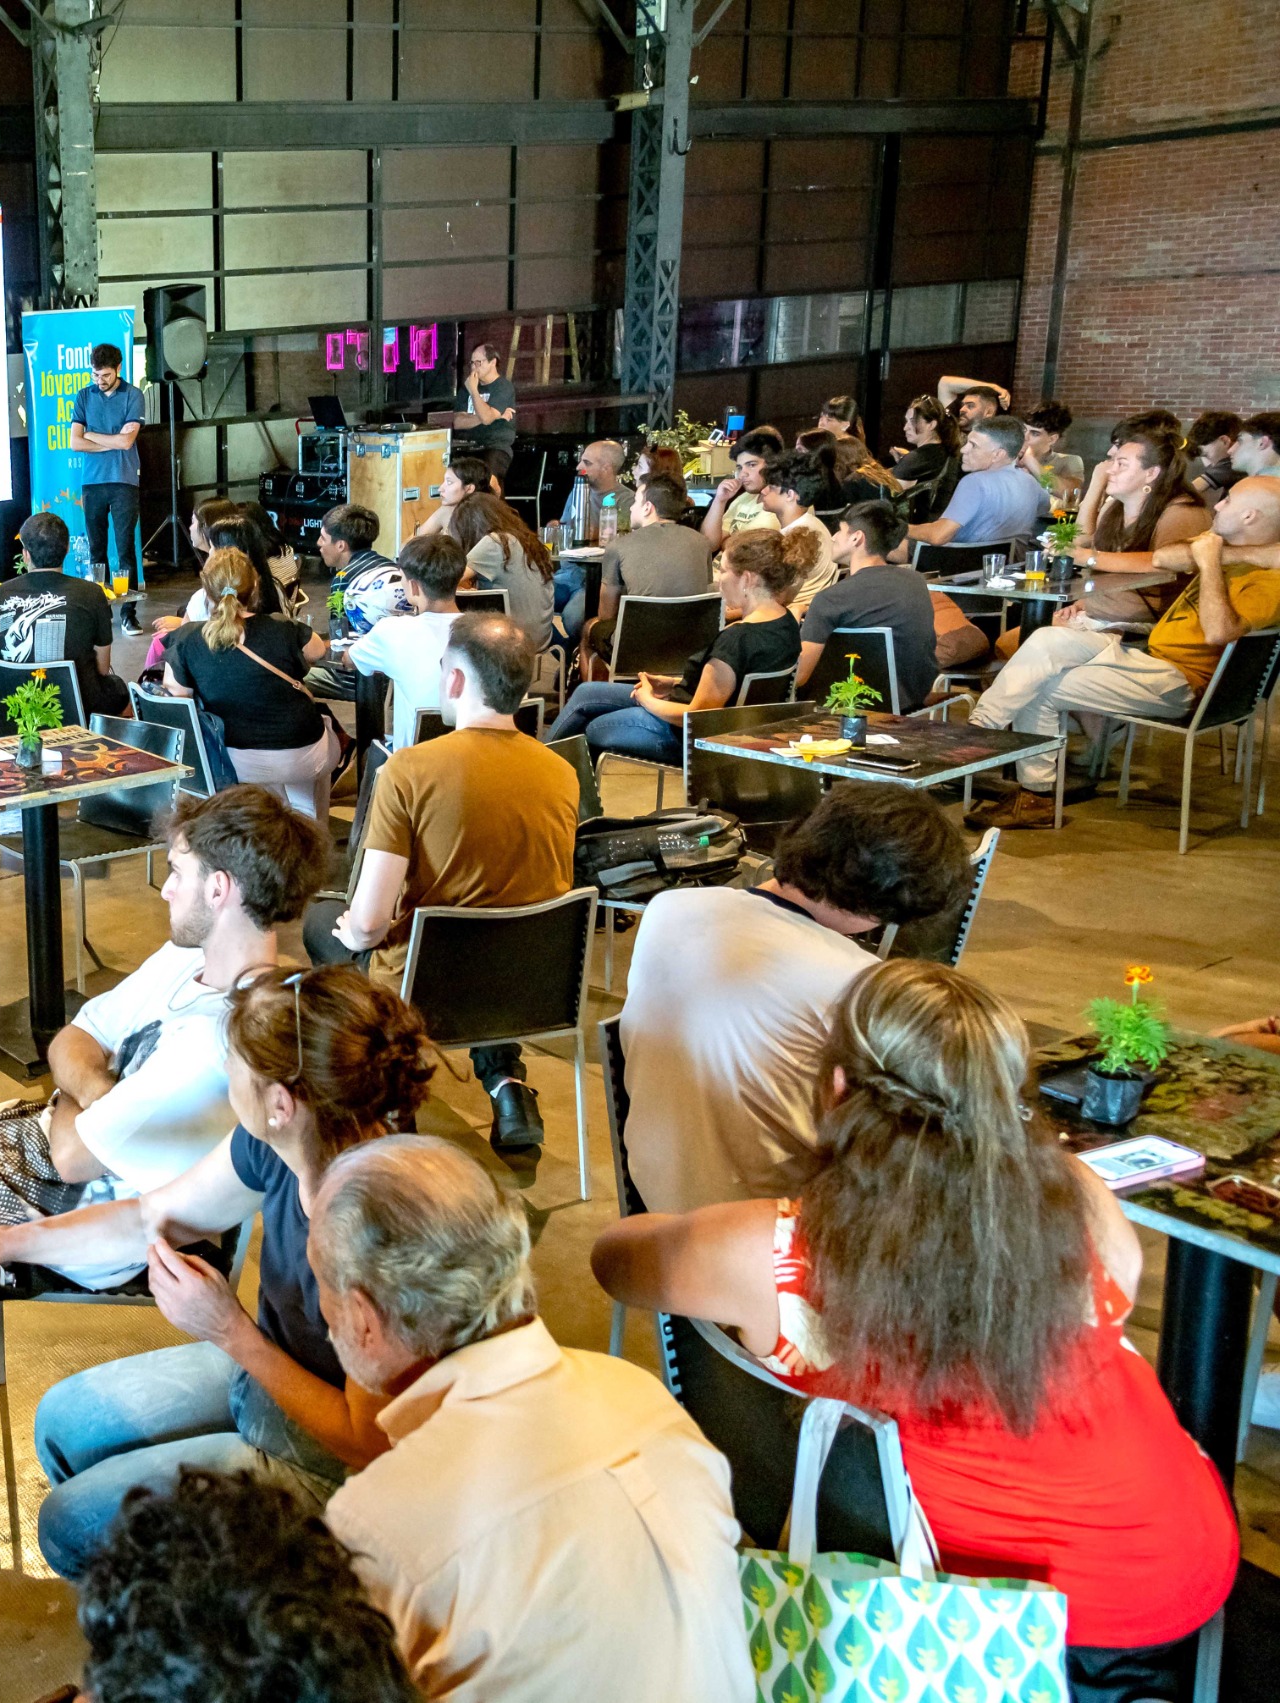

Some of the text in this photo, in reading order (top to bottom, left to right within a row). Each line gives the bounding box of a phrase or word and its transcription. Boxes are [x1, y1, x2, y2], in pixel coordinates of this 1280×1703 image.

[57, 342, 93, 370] Fond
[40, 370, 91, 397] Jóvene
[68, 457, 82, 469] ROS
